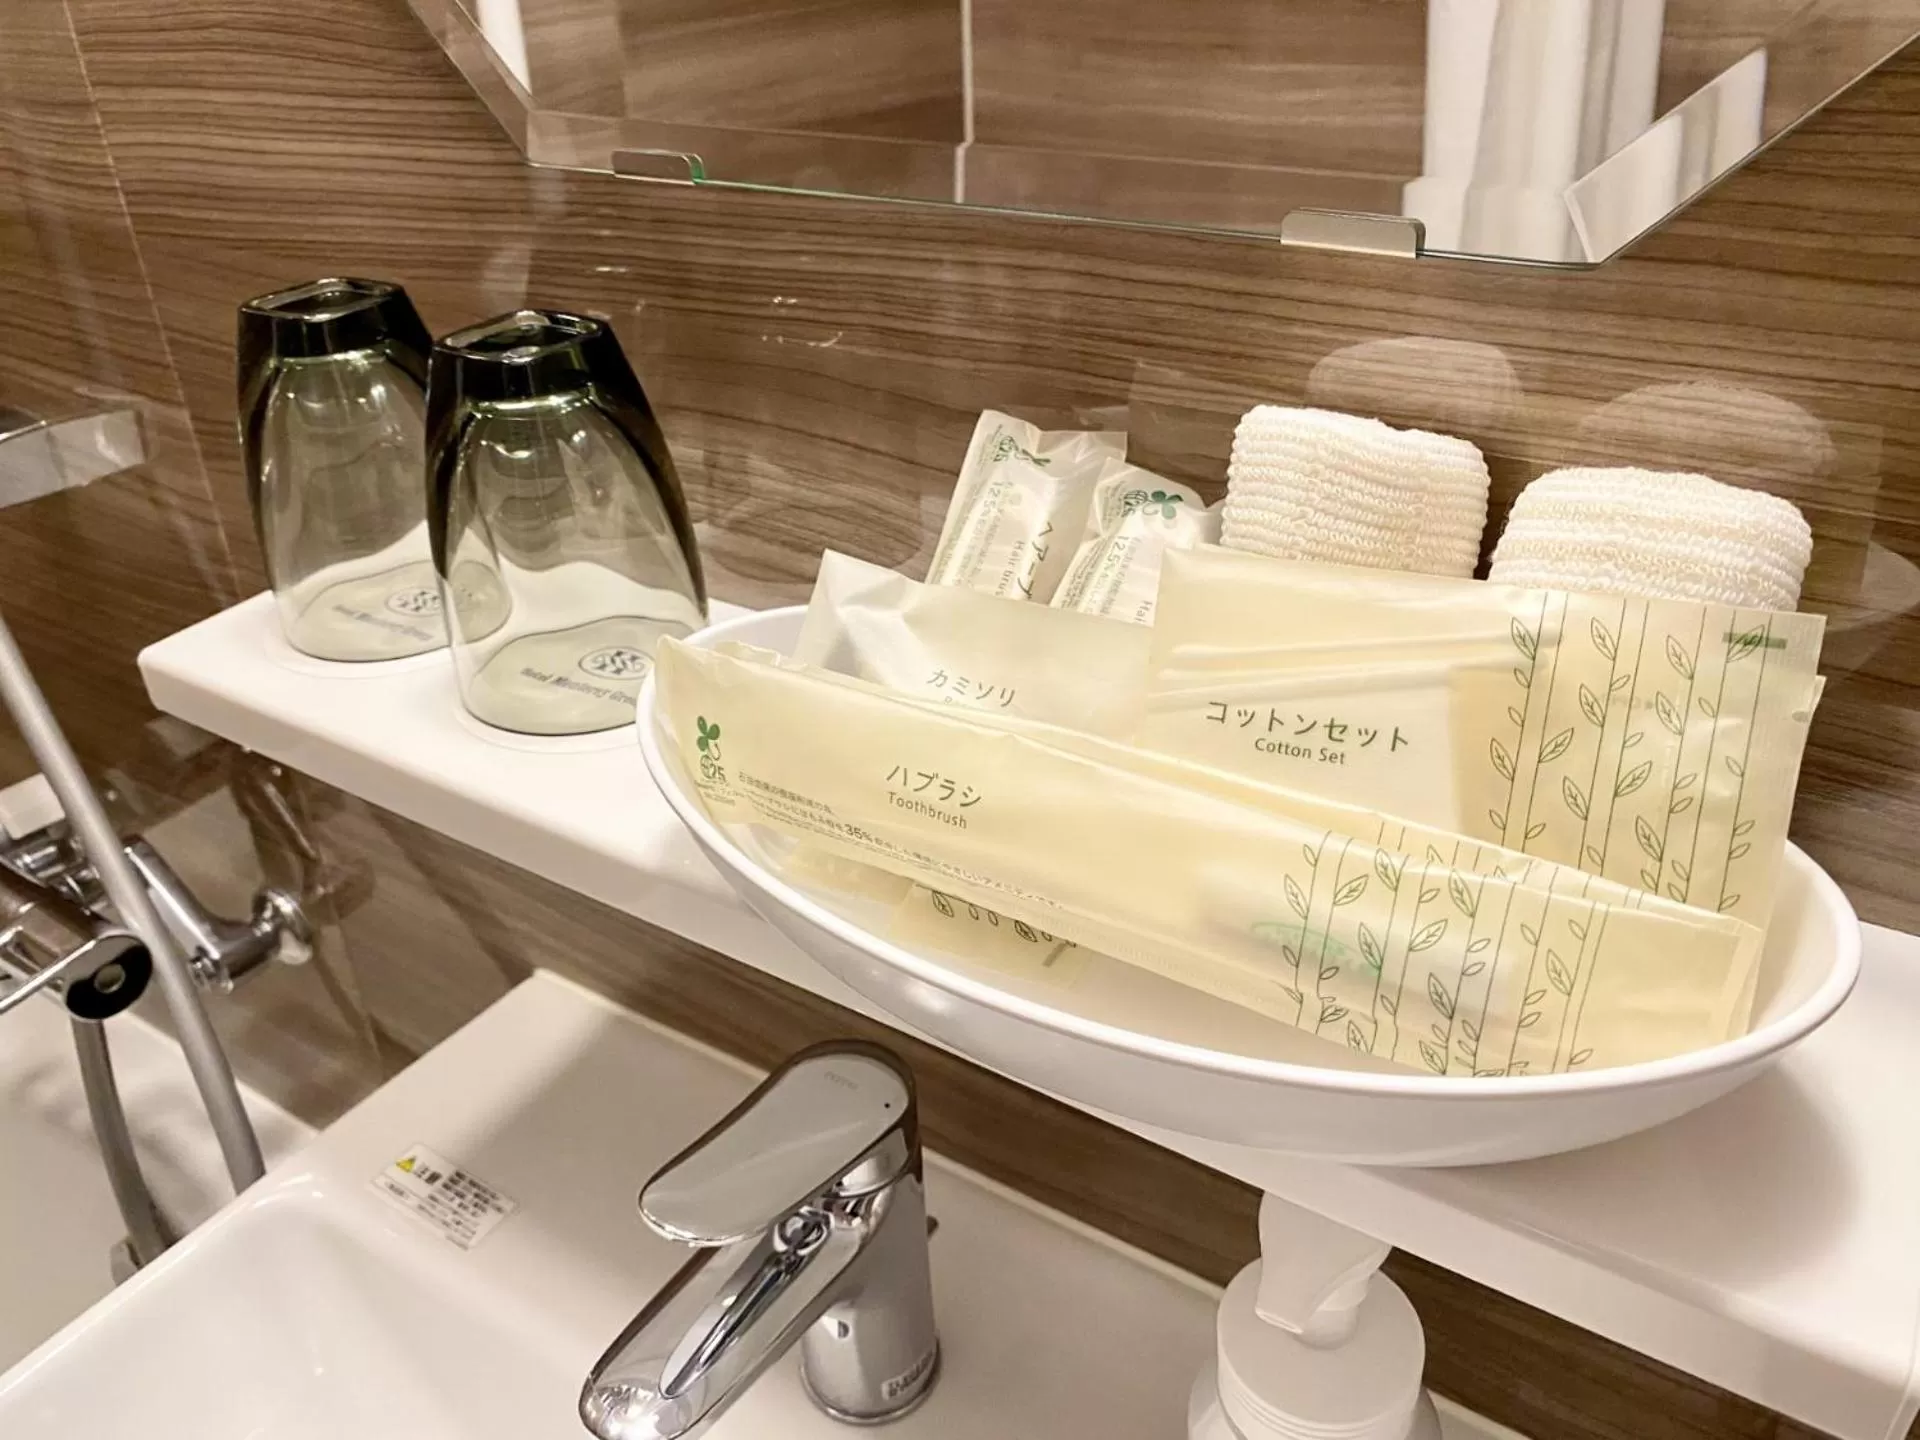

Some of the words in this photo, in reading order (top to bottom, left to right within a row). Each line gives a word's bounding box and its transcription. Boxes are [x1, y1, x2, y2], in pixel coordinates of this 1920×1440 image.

[926, 669, 1015, 708] カミソリ
[1206, 701, 1409, 752] コットンセット
[1254, 737, 1312, 759] Cotton
[1319, 747, 1346, 765] Set
[886, 765, 982, 807] ハブラシ
[887, 791, 968, 829] Toothbrush
